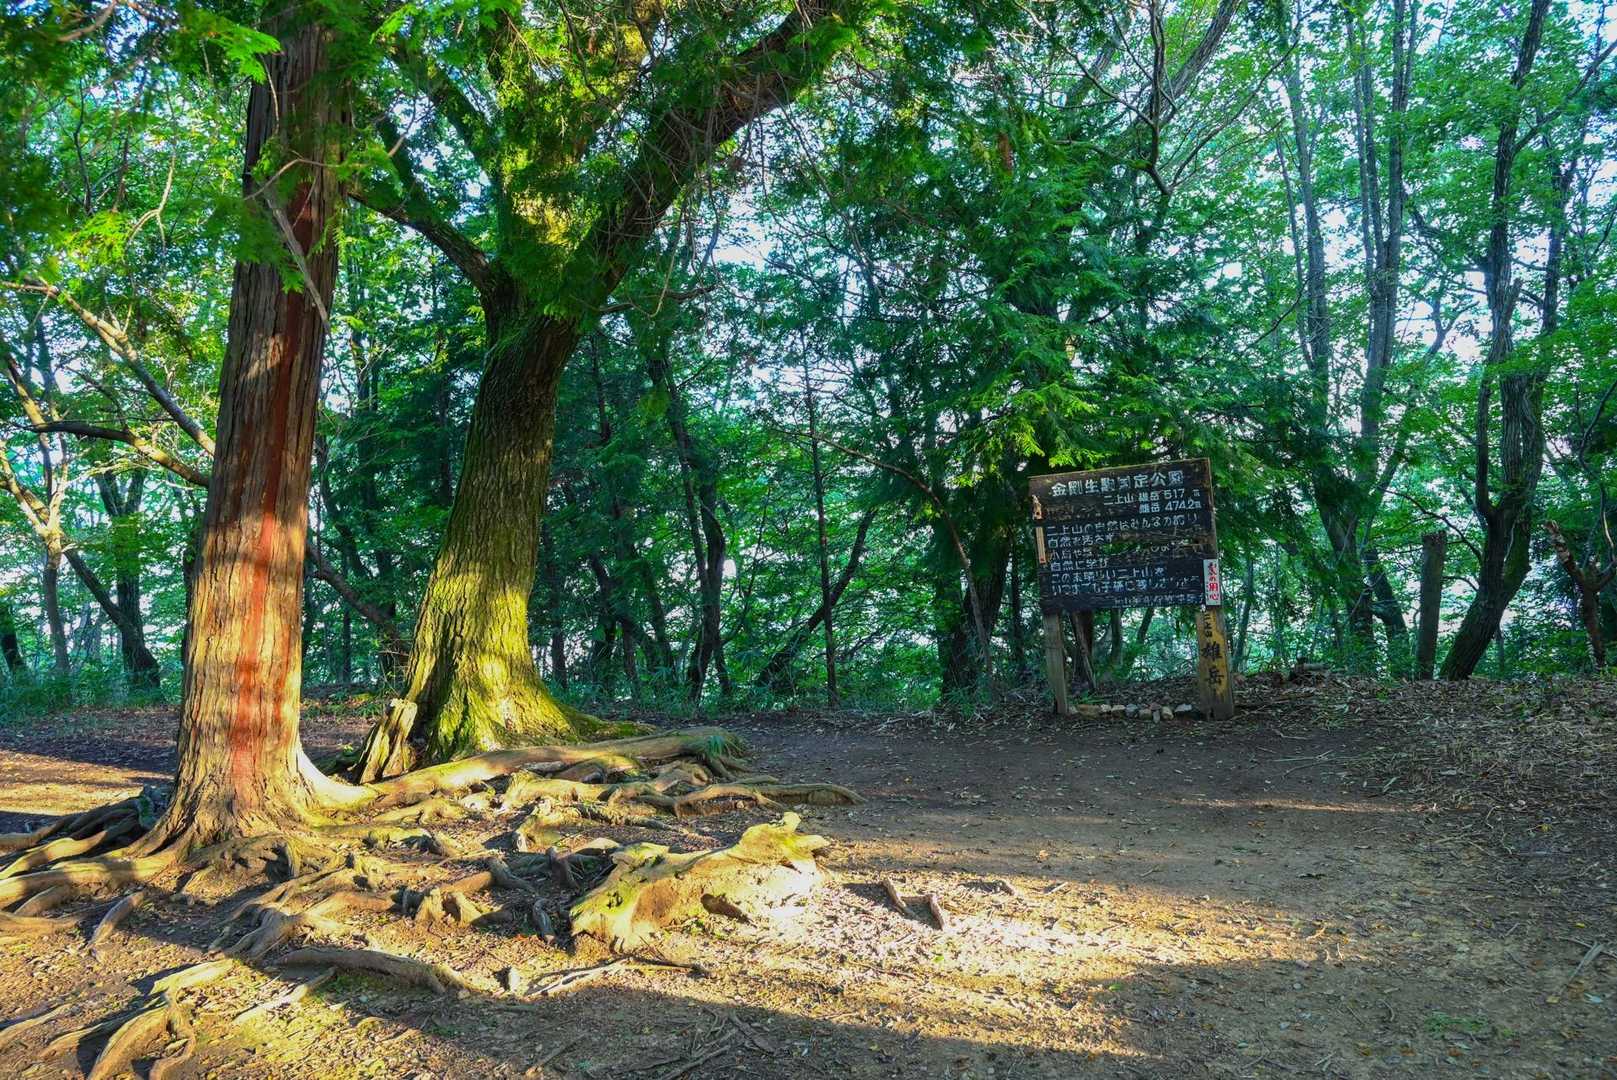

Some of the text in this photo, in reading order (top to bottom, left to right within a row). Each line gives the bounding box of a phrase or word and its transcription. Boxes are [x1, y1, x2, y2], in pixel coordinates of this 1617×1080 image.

[1103, 493, 1134, 506] 二上山
[1163, 488, 1185, 500] 517
